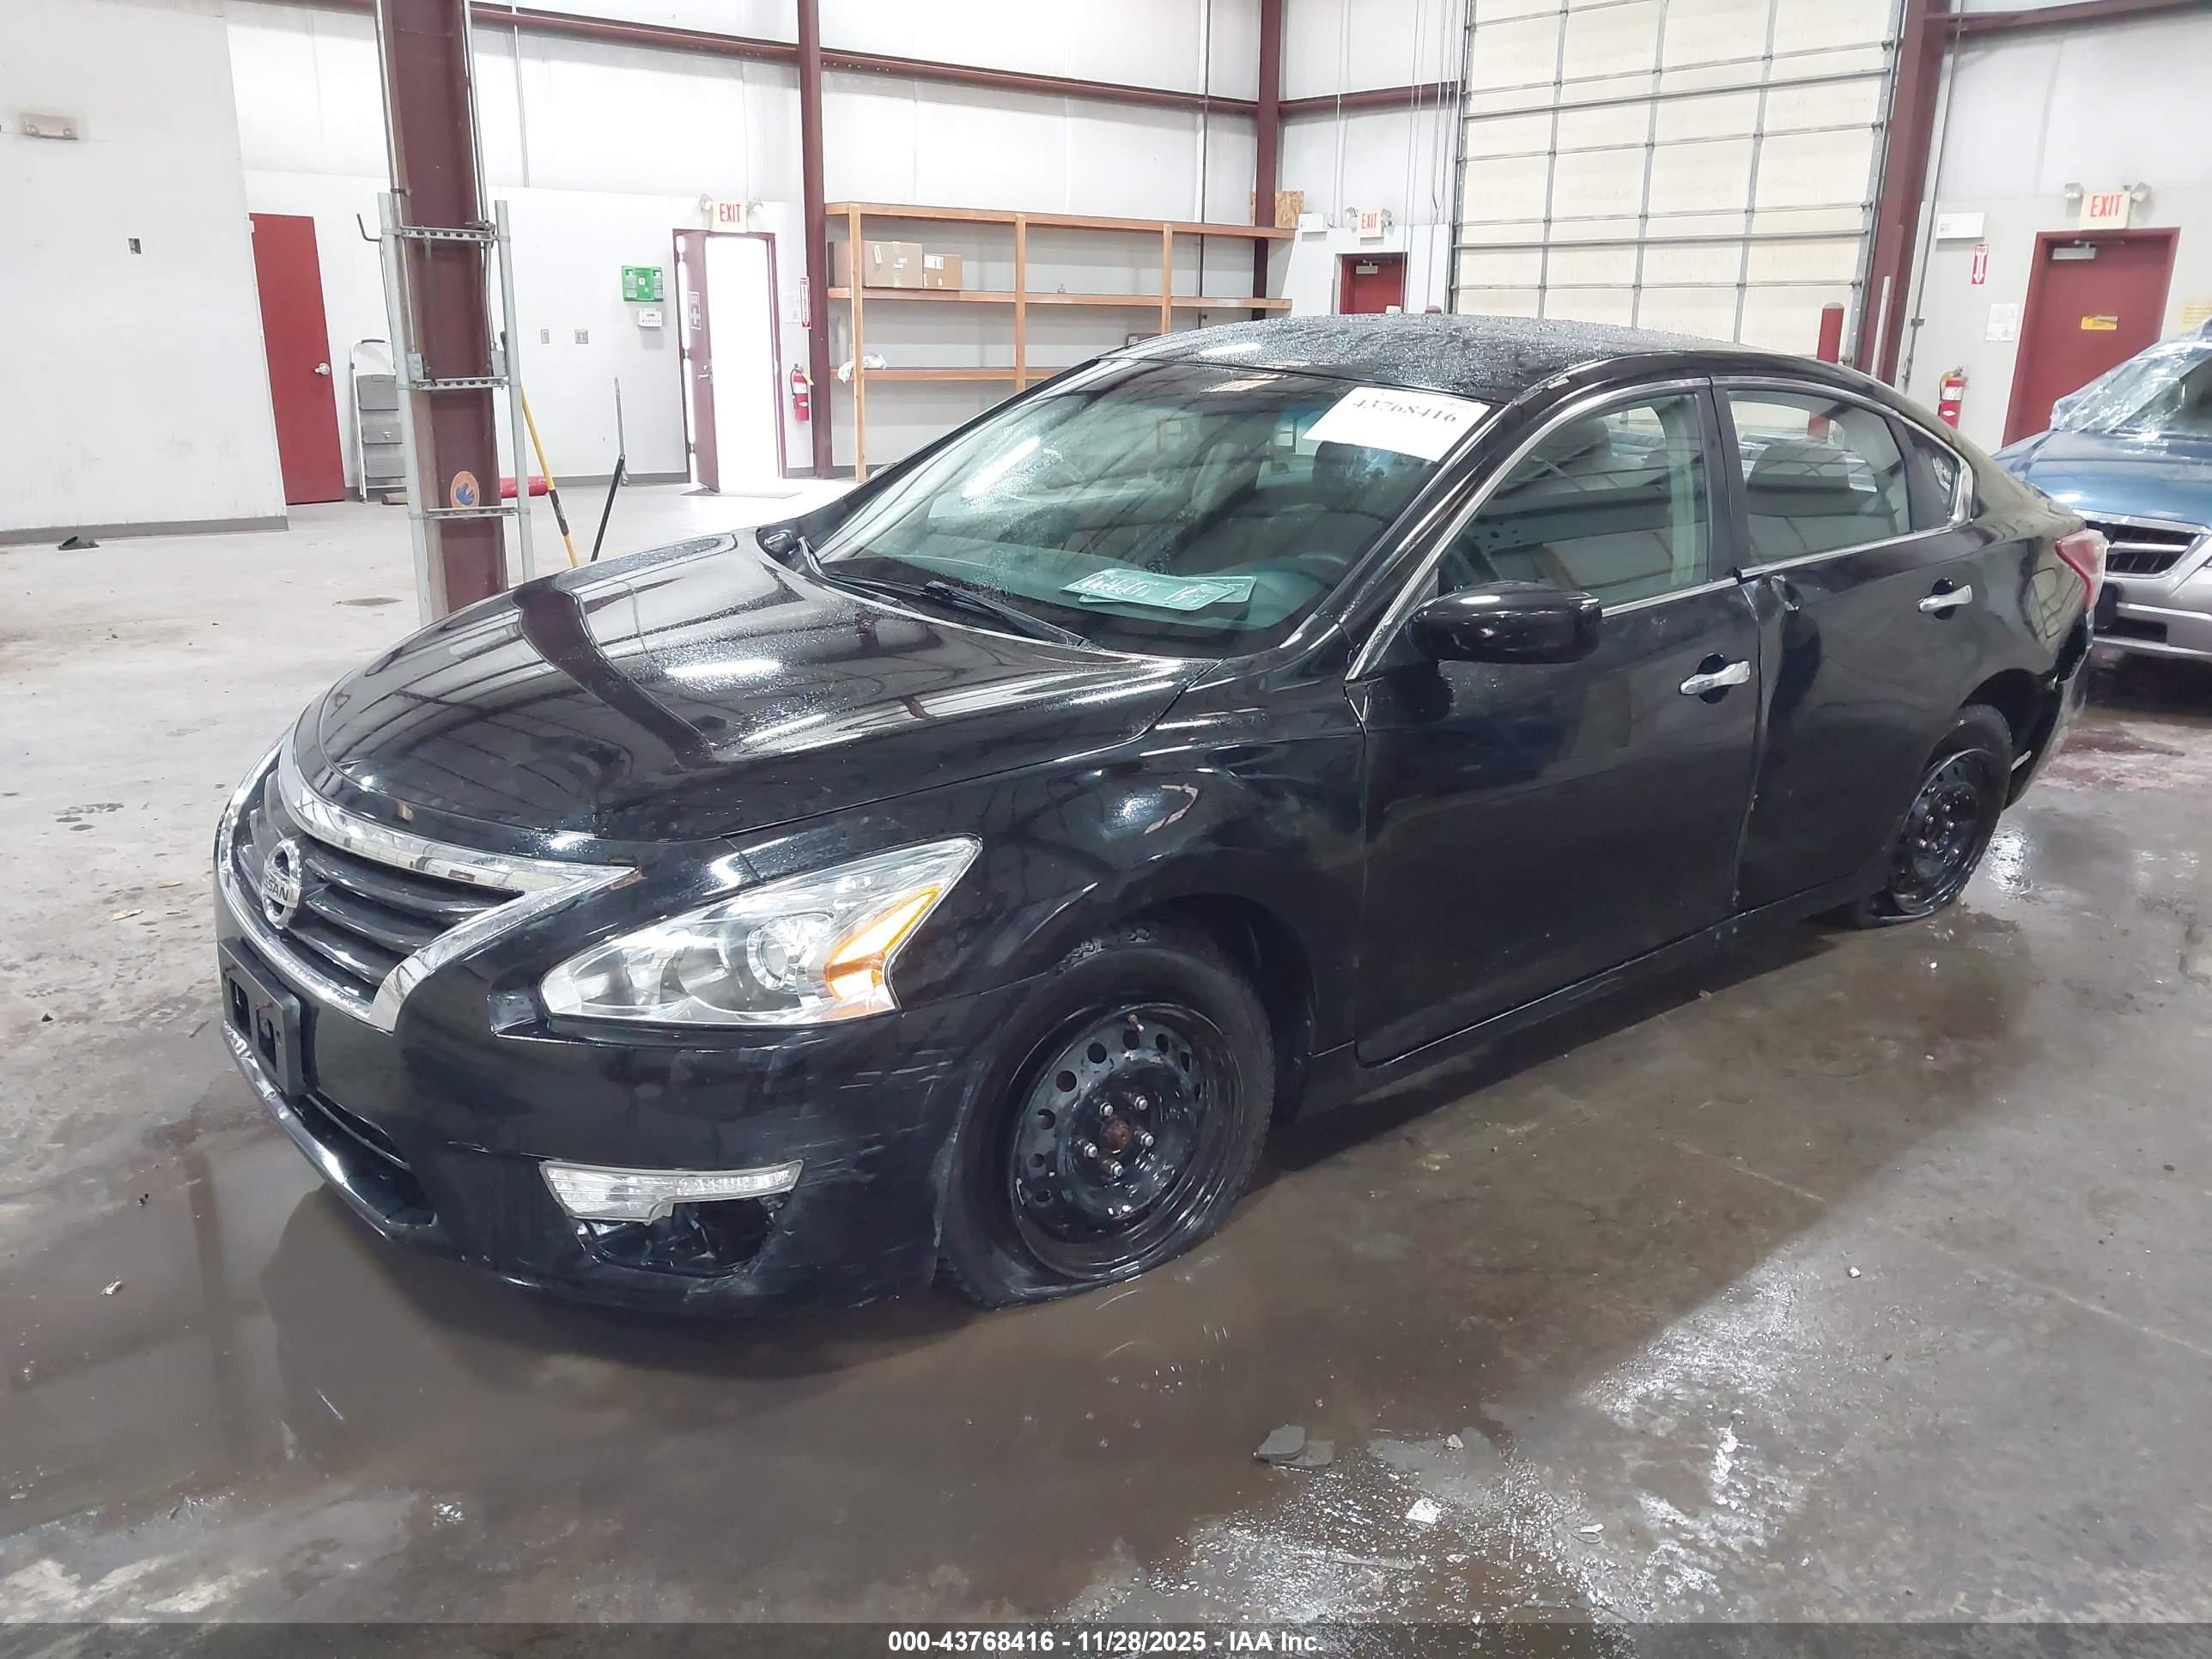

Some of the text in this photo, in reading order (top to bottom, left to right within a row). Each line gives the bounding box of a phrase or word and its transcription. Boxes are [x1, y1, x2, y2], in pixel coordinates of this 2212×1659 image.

[720, 203, 741, 223] EXIT
[2089, 194, 2124, 217] EXIT
[1361, 212, 1378, 229] EXIT
